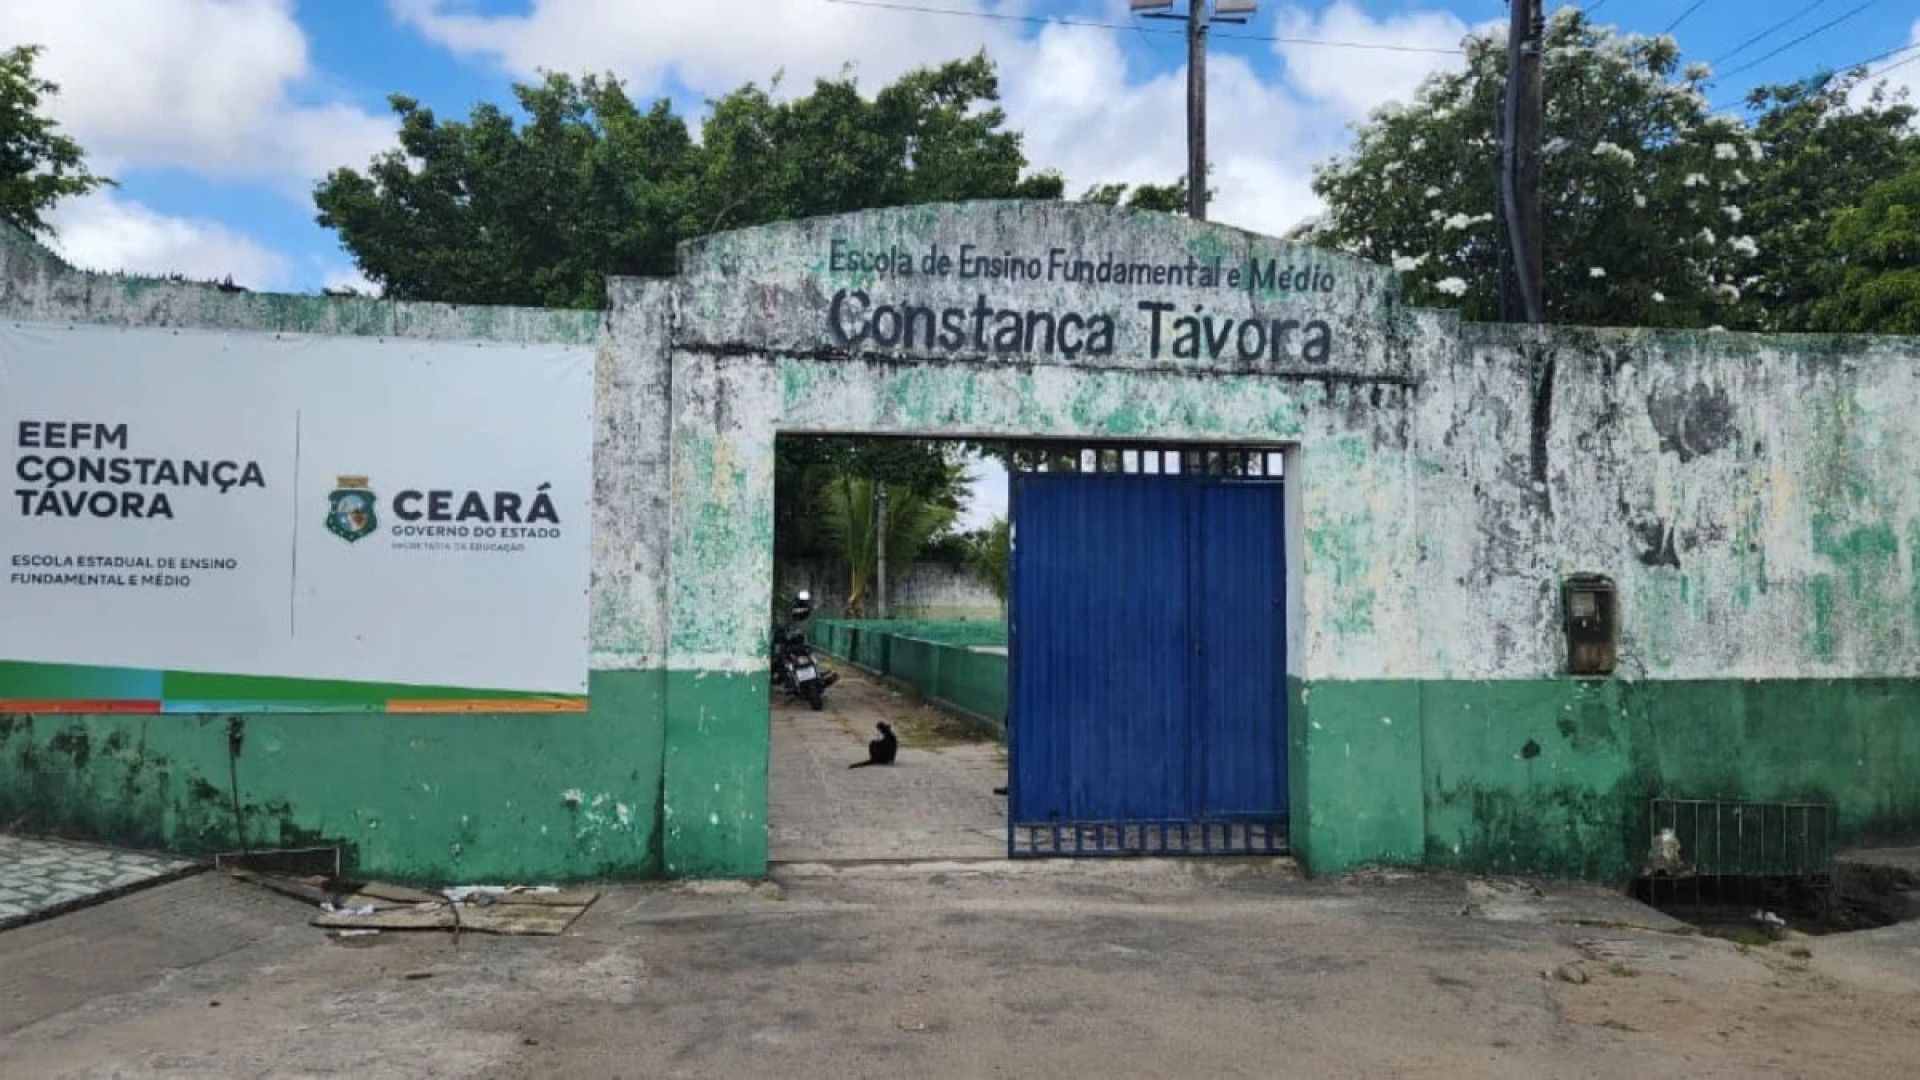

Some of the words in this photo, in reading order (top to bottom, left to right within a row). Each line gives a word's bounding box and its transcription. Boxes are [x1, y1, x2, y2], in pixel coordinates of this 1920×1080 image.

[828, 239, 913, 275] Escola
[921, 243, 951, 276] de
[959, 244, 1041, 280] Ensino
[1049, 247, 1221, 287] Fundamental
[1227, 266, 1241, 289] e
[1250, 257, 1335, 292] Médio
[828, 288, 1115, 359] Constança
[1138, 300, 1332, 364] Távora
[18, 421, 128, 450] EEFM
[16, 454, 266, 494] CONSTANÇA
[14, 481, 174, 519] TÁVORA
[391, 481, 560, 523] CEARÁ
[391, 525, 470, 537] GOVERNO
[473, 526, 496, 538] DO
[500, 527, 561, 539] ESTADO
[10, 572, 125, 586] FUNDAMENTAL
[128, 574, 138, 586] E
[141, 571, 191, 587] MÉDIO
[12, 554, 73, 567] ESCOLA
[76, 555, 153, 568] ESTADUAL
[157, 557, 176, 569] DE
[180, 557, 238, 570] ENSINO
